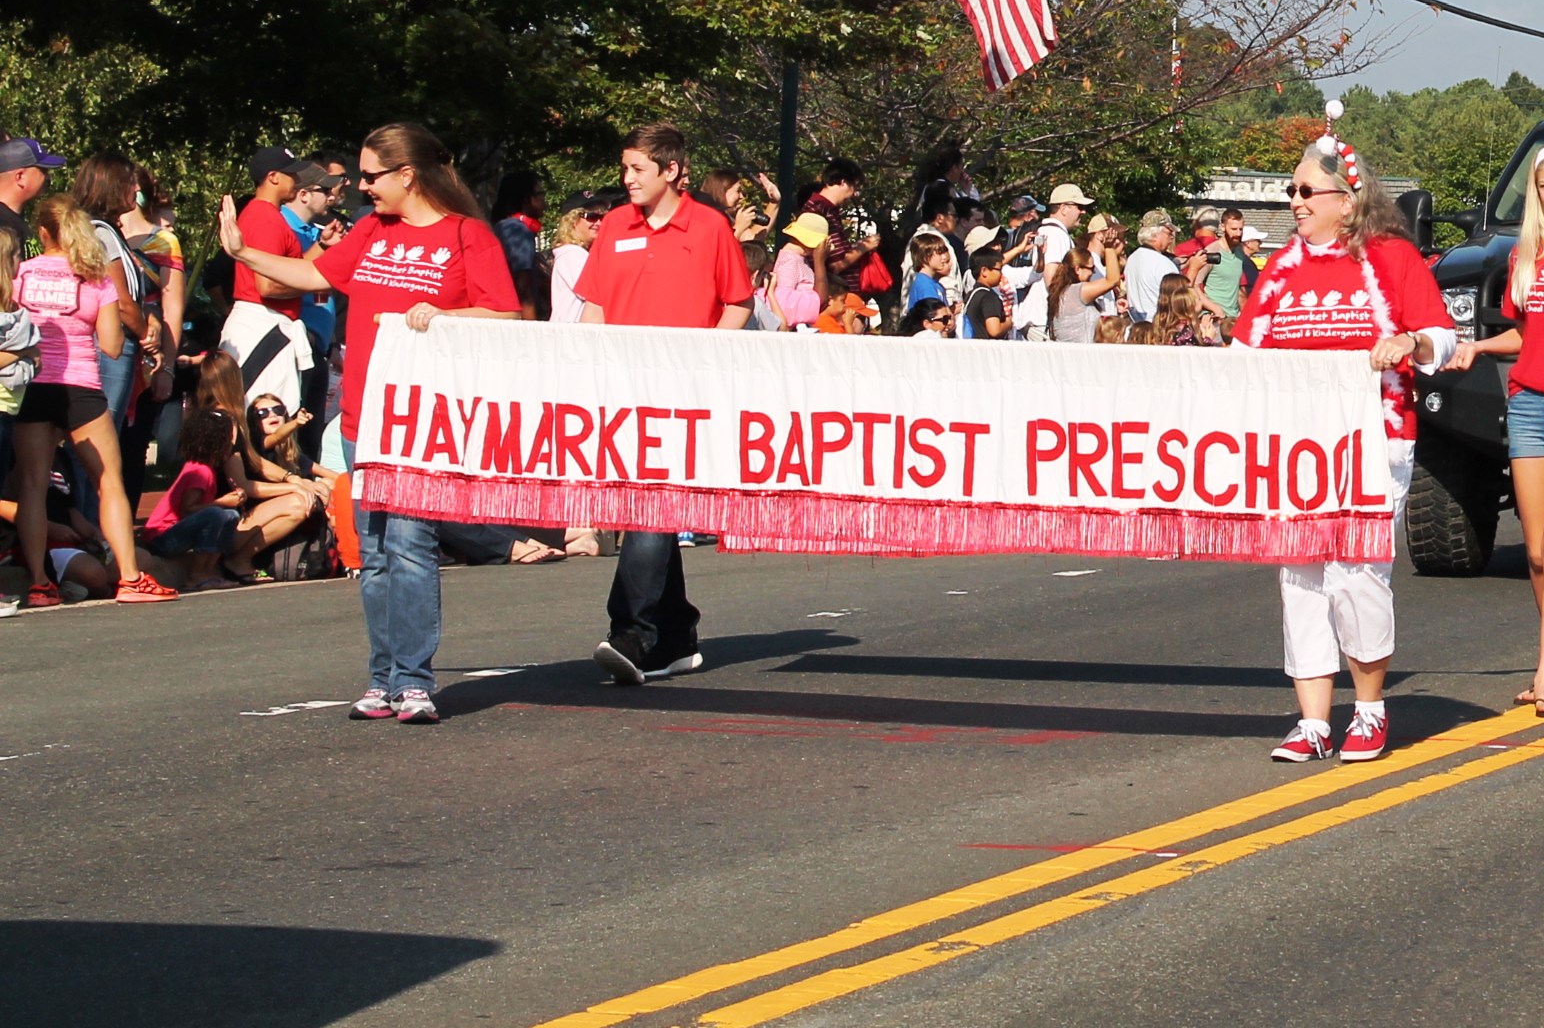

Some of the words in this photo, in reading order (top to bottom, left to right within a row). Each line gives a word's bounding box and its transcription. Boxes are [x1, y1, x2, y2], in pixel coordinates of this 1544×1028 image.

[34, 267, 71, 279] Reebok
[407, 266, 443, 280] Baptist
[26, 277, 77, 293] CrossFit
[388, 279, 439, 296] Kindergarten
[25, 289, 77, 306] GAMES
[1331, 310, 1370, 322] Baptist
[1305, 329, 1311, 337] &
[1313, 329, 1373, 340] Kindergarten
[380, 383, 711, 480] HAYMARKET
[740, 410, 990, 497] BAPTIST
[1027, 419, 1386, 511] PRESCHOOL
